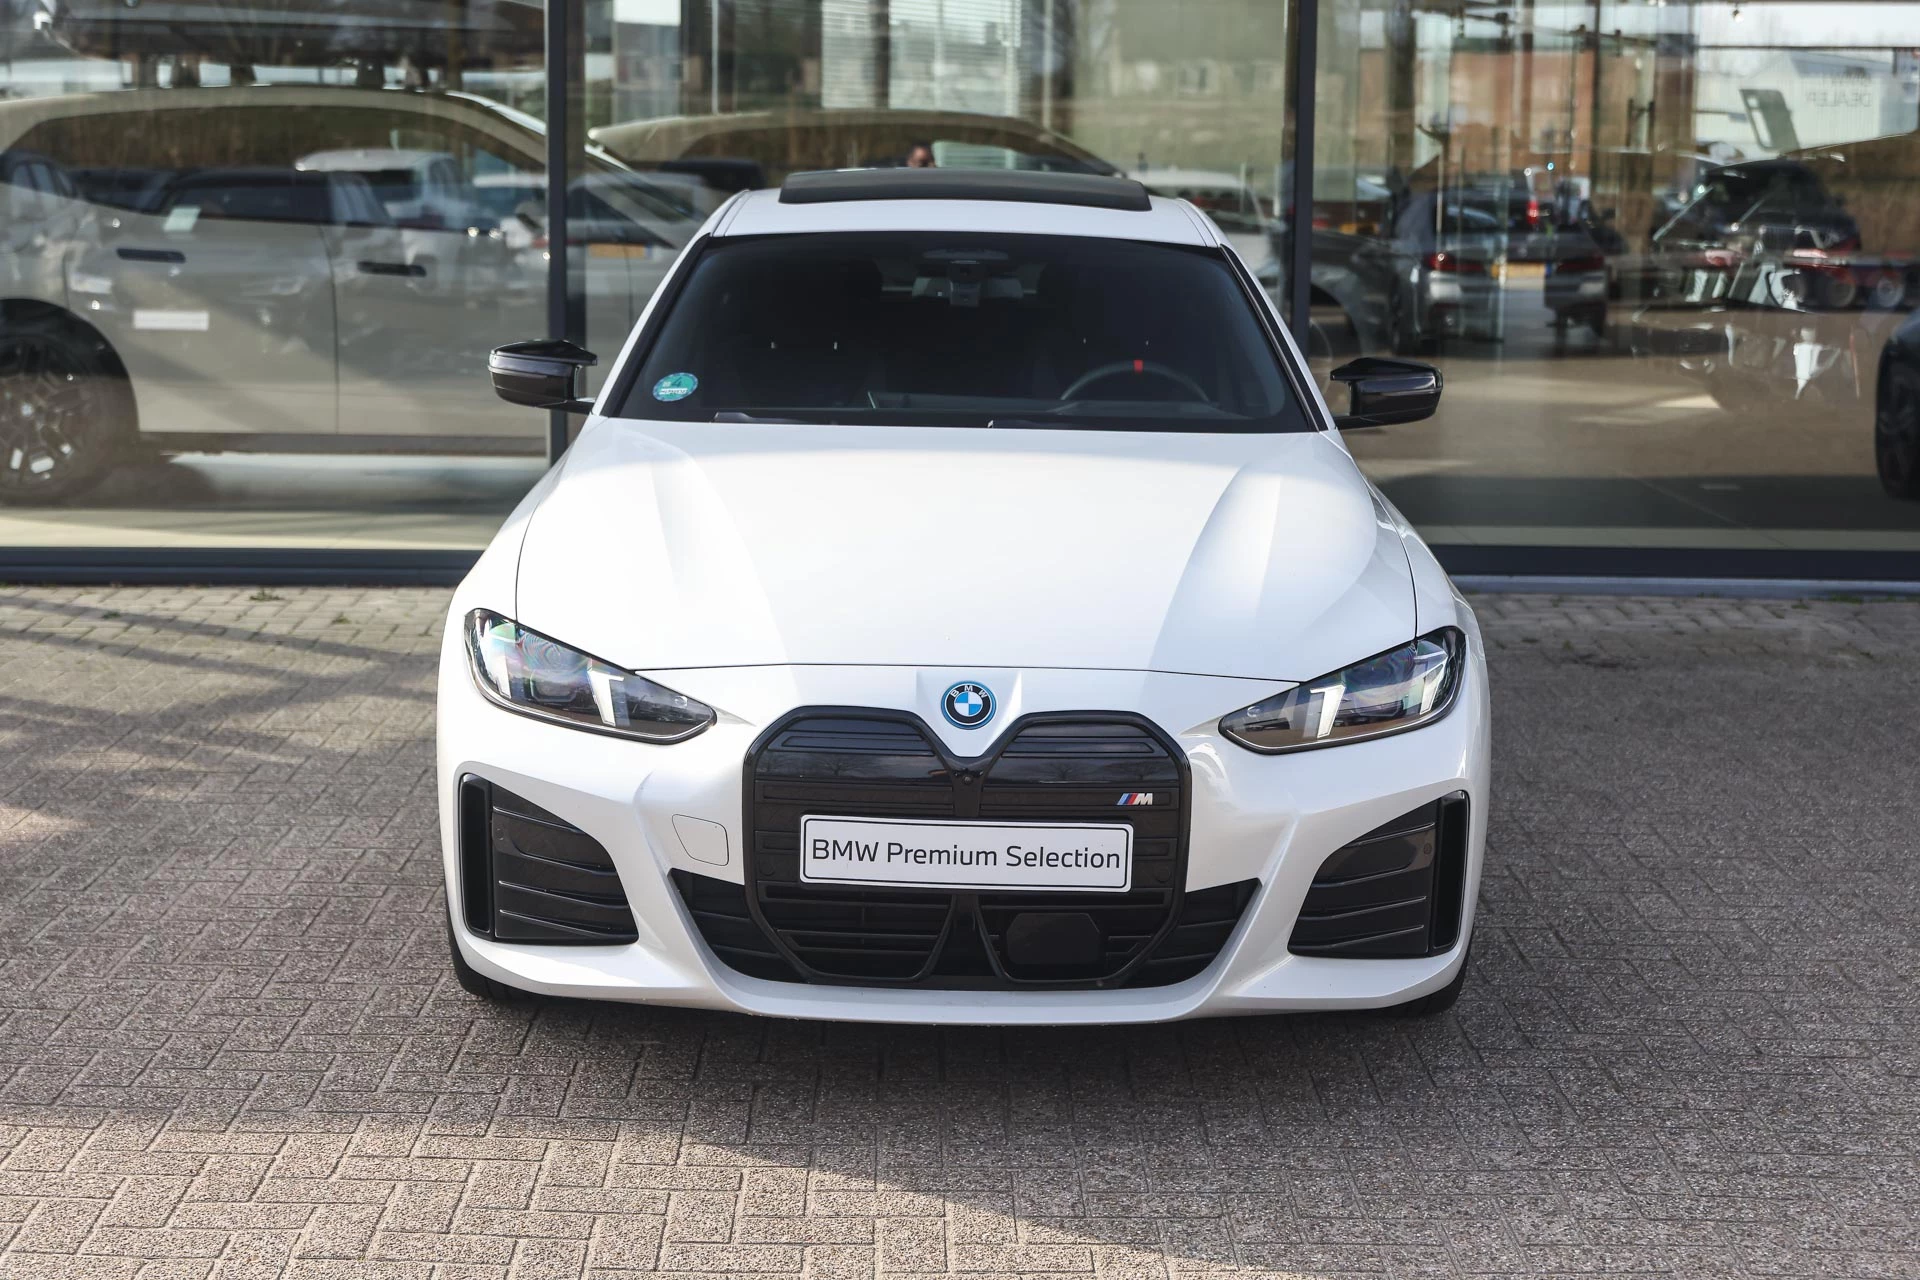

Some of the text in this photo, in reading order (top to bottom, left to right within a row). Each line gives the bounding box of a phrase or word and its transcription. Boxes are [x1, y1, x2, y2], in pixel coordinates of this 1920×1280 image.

[950, 685, 988, 698] BMW
[1132, 792, 1153, 806] M
[812, 838, 1120, 869] BMW Premium Selection
